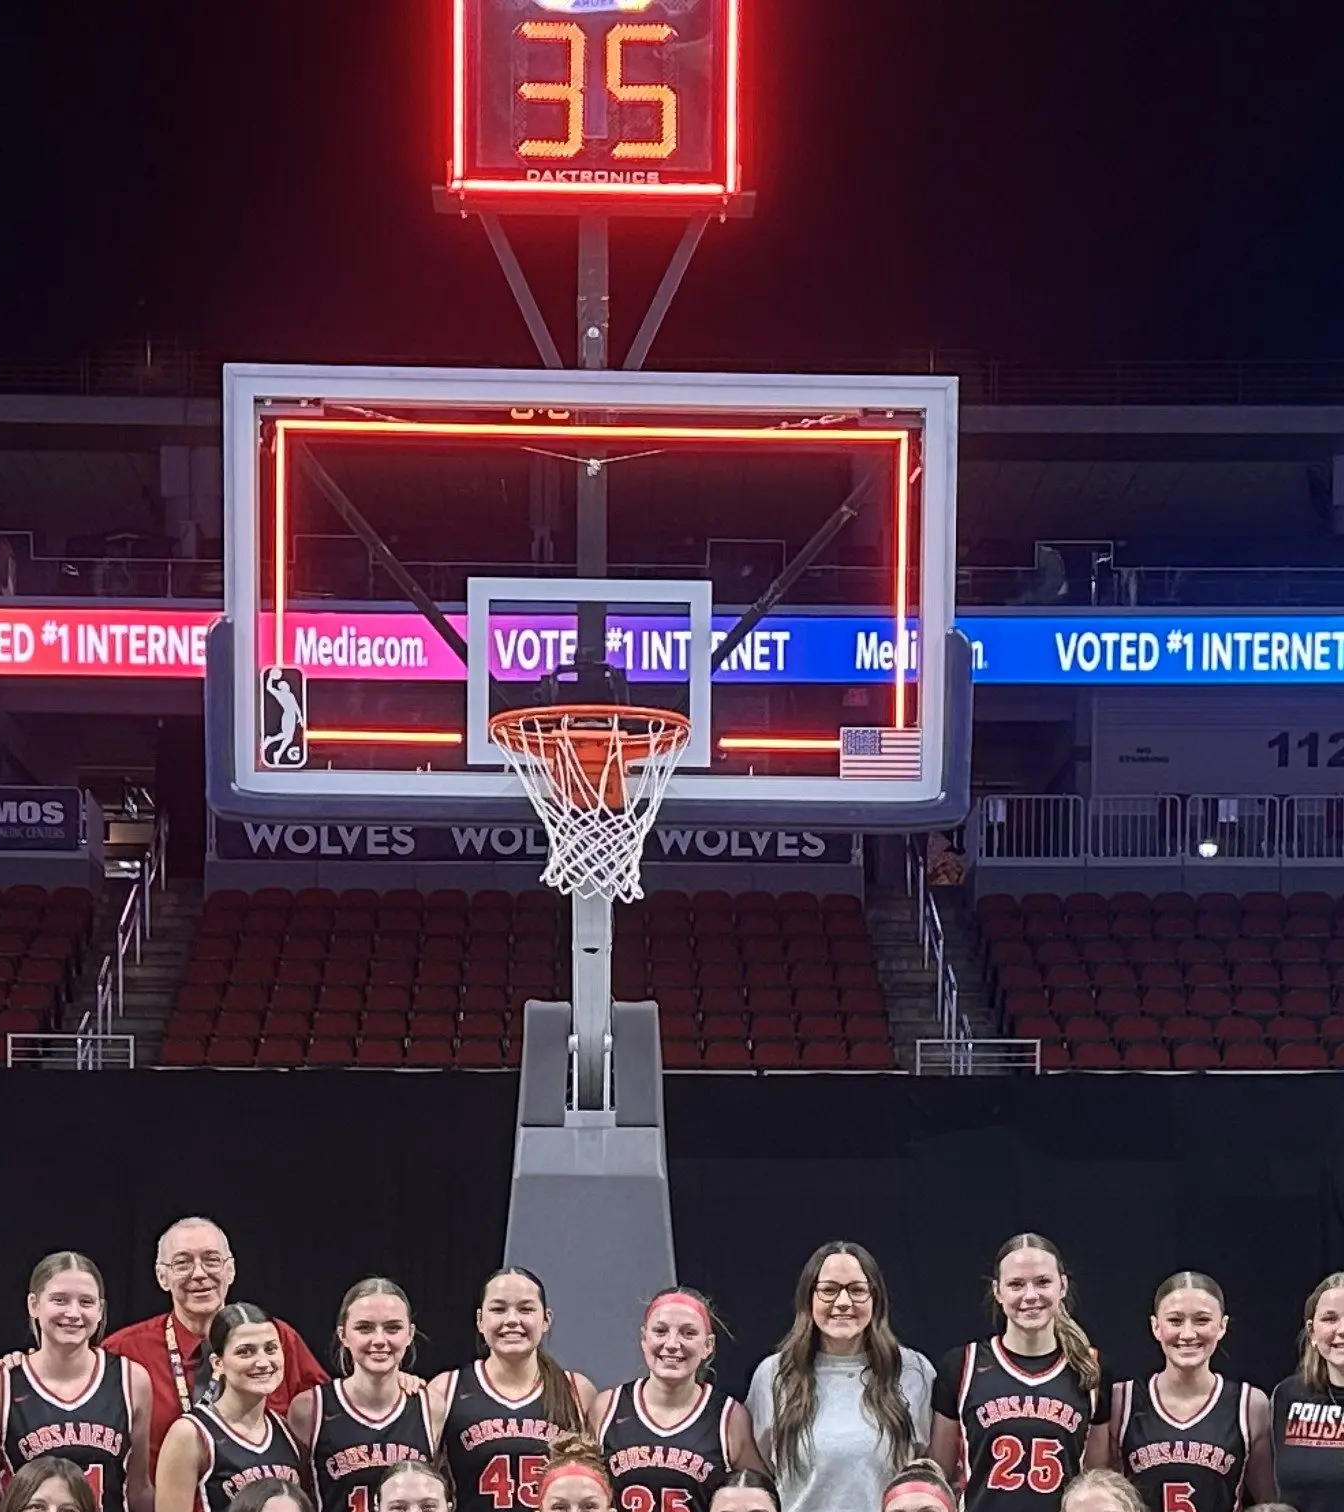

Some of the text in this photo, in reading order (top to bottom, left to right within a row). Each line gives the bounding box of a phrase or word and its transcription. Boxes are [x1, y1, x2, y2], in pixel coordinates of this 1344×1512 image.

[516, 21, 677, 159] 35
[526, 169, 659, 184] DAKTRONICS
[41, 622, 70, 664] #1
[77, 625, 206, 666] INTERNE
[294, 627, 428, 667] Mediacom
[494, 629, 577, 670] VOTE
[606, 626, 634, 670] #1
[641, 631, 790, 671] INTRNET
[1056, 631, 1158, 672] VOTED
[1167, 629, 1194, 672] #1
[245, 823, 415, 856] WOLVES
[657, 827, 826, 858] WOLVES
[976, 1395, 1083, 1433] CRUSADERS
[18, 1422, 123, 1461] CRUSADERS
[1129, 1441, 1236, 1475] CRUSADERS
[609, 1446, 714, 1482] CRUSADERS
[987, 1435, 1065, 1493] 25
